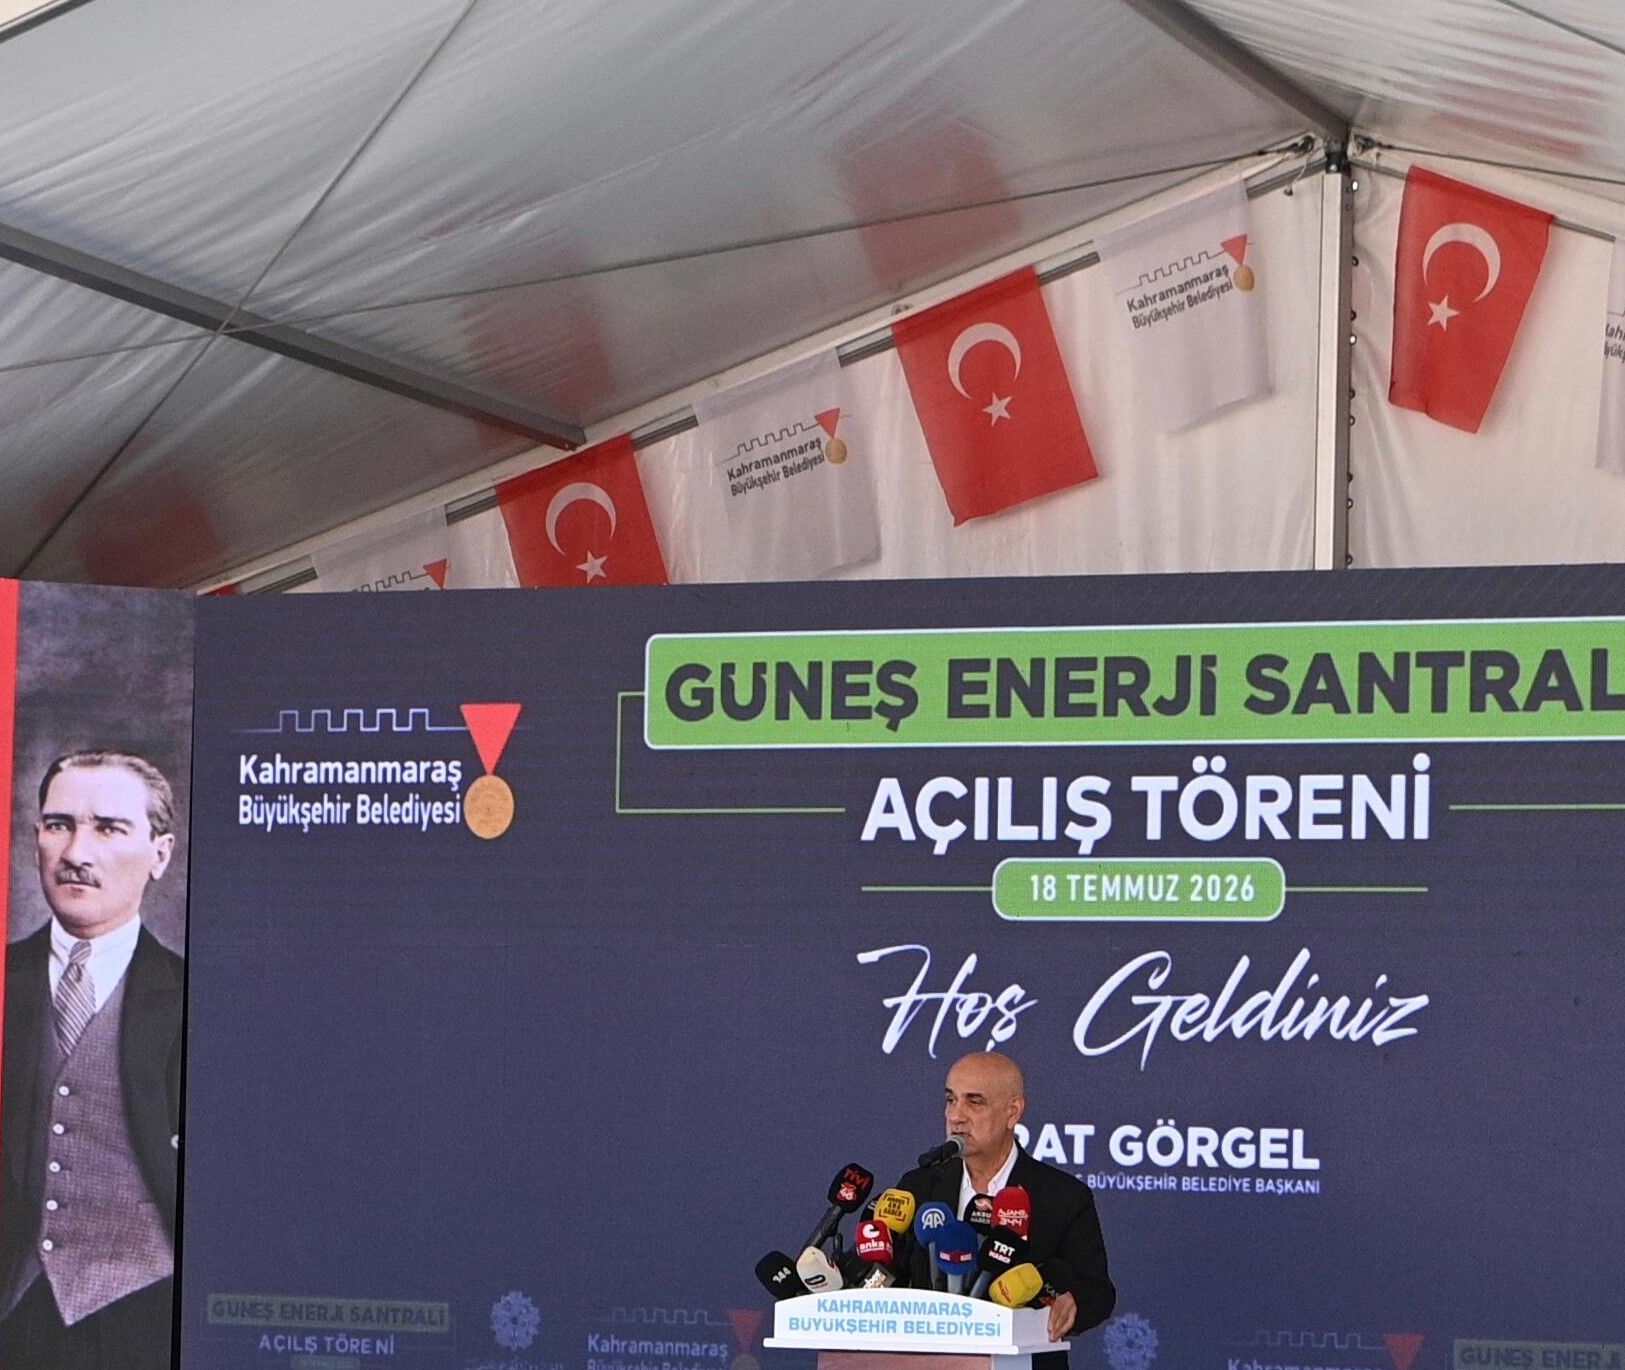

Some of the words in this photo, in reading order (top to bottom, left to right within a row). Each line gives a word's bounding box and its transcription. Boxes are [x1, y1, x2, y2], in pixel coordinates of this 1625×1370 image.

[1127, 264, 1229, 312] Kahramanmaraş
[1186, 276, 1233, 308] Belediyesi
[727, 437, 822, 481] Kahramanmaraş
[782, 449, 825, 479] Belediyesi
[239, 753, 462, 792] Kahramanmaraş
[238, 793, 351, 832] Büyükşehir
[356, 793, 460, 832] Belediyesi
[861, 777, 1113, 855] AÇILIŞ
[1131, 752, 1430, 840] TÖRENİ
[1031, 874, 1056, 902] 18
[1066, 874, 1180, 902] TEMMUZ
[1190, 873, 1255, 901] 2026
[857, 944, 1038, 1059] Hoş
[1073, 947, 1429, 1071] Geldiniz
[1109, 1118, 1320, 1170] GÖRGEL
[1087, 1171, 1177, 1192] BÜYÜKŞEHİR
[1182, 1174, 1250, 1193] BELEDİYE
[1255, 1178, 1320, 1196] BAŞKANI
[994, 1240, 1016, 1257] TRT
[817, 1299, 973, 1318] KAHRAMANMARAŞ
[587, 1334, 728, 1361] Kahramanmaraş
